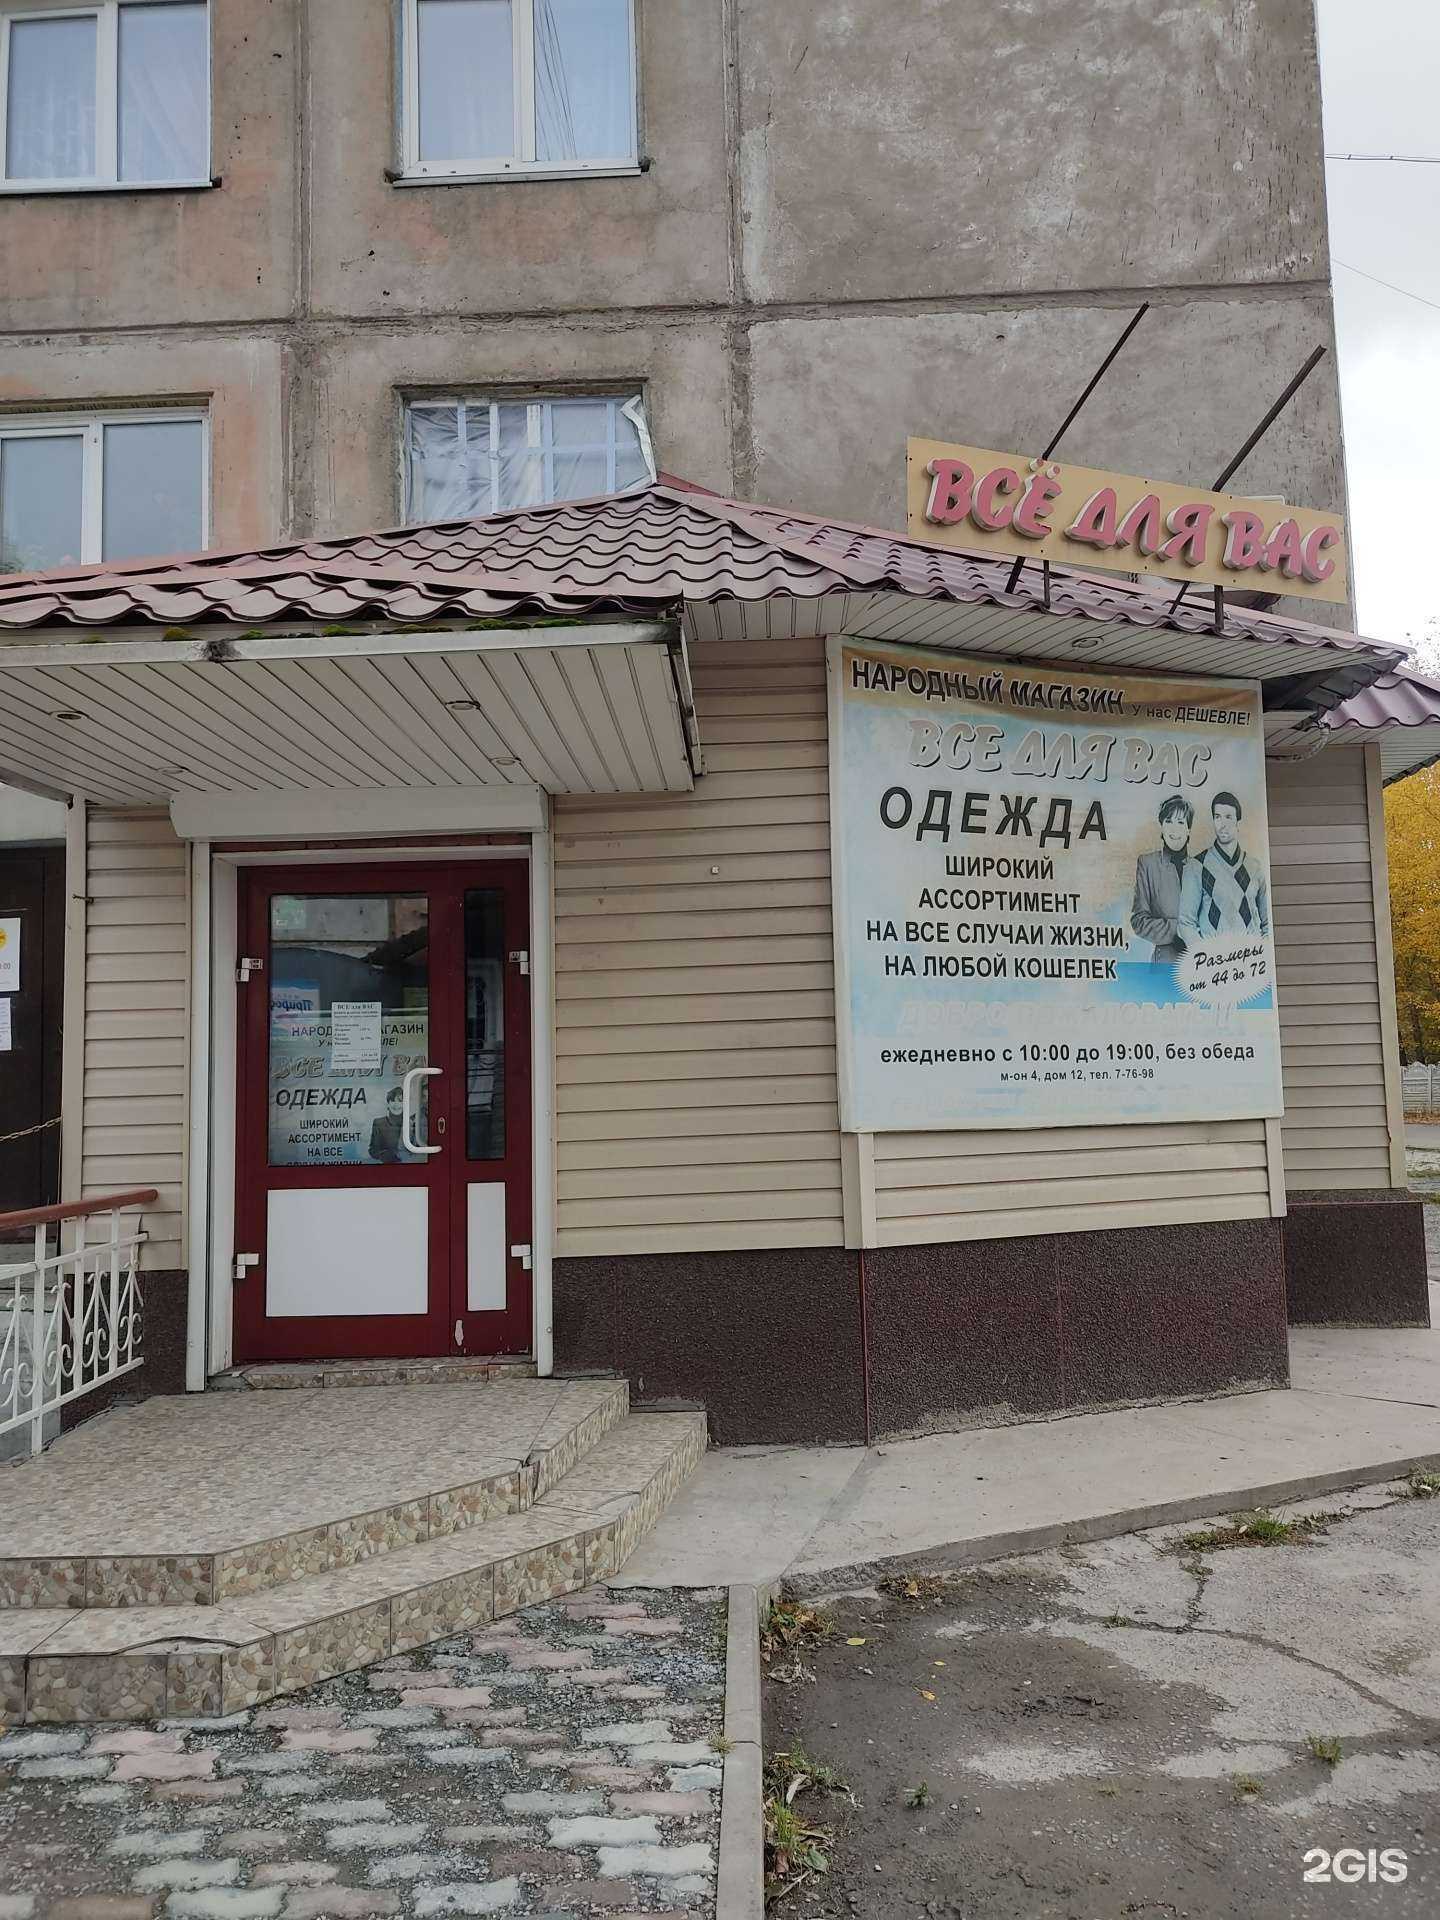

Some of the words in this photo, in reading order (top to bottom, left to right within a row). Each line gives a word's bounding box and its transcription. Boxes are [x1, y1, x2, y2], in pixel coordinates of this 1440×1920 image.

[926, 458, 1063, 539] ВСЁ
[1064, 487, 1215, 566] ДЛЯ
[1222, 511, 1339, 583] ВАС
[852, 661, 1004, 704] НАРОДНЫЙ
[1009, 680, 1125, 715] МАГАЗИН
[1145, 706, 1172, 719] нас
[1175, 706, 1251, 727] ДЕШЕВЛЕ!
[909, 720, 1004, 773] ВСЕ
[1012, 732, 1117, 783] ДЛЯ
[1122, 739, 1212, 788] ВАС
[880, 787, 1108, 849] ОДЕЖДА
[945, 854, 1054, 880] ШИРОКИЙ
[918, 888, 1080, 914] АССОРТИМЕНТ
[867, 920, 898, 941] НА
[905, 921, 950, 943] ВСЕ
[957, 923, 1044, 946] СЛУЧАИ
[1049, 925, 1129, 950] ЖИЗНИ,
[884, 956, 916, 976] НА
[922, 953, 1008, 978] ЛЮБОЙ
[1015, 957, 1117, 980] КОШЕЛЕК
[1193, 944, 1264, 971] Размеры
[1189, 978, 1207, 992] от
[1211, 970, 1230, 987] 44
[1231, 967, 1246, 982] до
[1250, 961, 1268, 978] 72
[292, 1025, 332, 1037] НАРОД
[880, 1045, 996, 1064] ежедневно
[1003, 1049, 1013, 1062] с
[1019, 1044, 1070, 1062] 10:00
[1076, 1047, 1100, 1065] до
[1106, 1044, 1160, 1064] 19:00,
[1166, 1043, 1196, 1060] без
[1201, 1043, 1255, 1062] обеда
[1000, 1072, 1028, 1081] м-он
[1030, 1070, 1040, 1082] 4,
[1044, 1071, 1067, 1082] дом
[1070, 1069, 1086, 1082] 12,
[1089, 1070, 1112, 1081] тел.
[1115, 1069, 1154, 1080] 7-76-98
[275, 1087, 367, 1110] ОДЕЖДА
[299, 1117, 349, 1130] ШИРОКИЙ
[288, 1132, 361, 1144] АССОРТИМЕНТ
[307, 1147, 321, 1157] НА
[323, 1146, 344, 1157] ВСЕ
